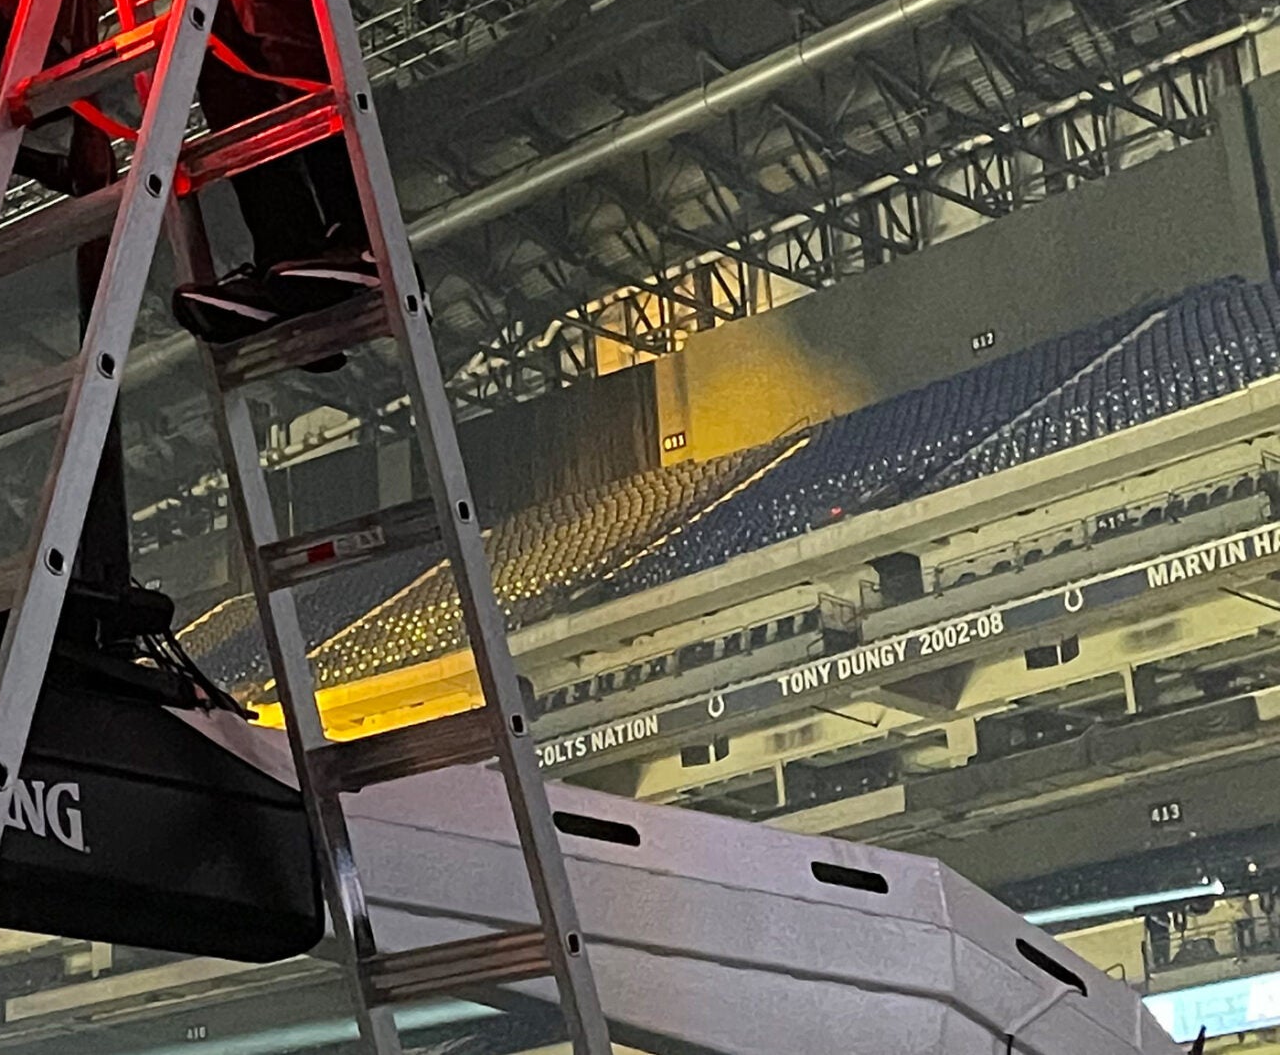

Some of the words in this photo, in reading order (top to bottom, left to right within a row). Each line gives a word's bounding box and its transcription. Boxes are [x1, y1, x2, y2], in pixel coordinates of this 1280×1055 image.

[1147, 540, 1246, 588] MARVIN
[778, 662, 832, 696] TONY
[837, 641, 908, 680] DUNGY
[919, 612, 1004, 656] 2002-08
[591, 714, 658, 752] NATION
[1152, 804, 1180, 822] 413
